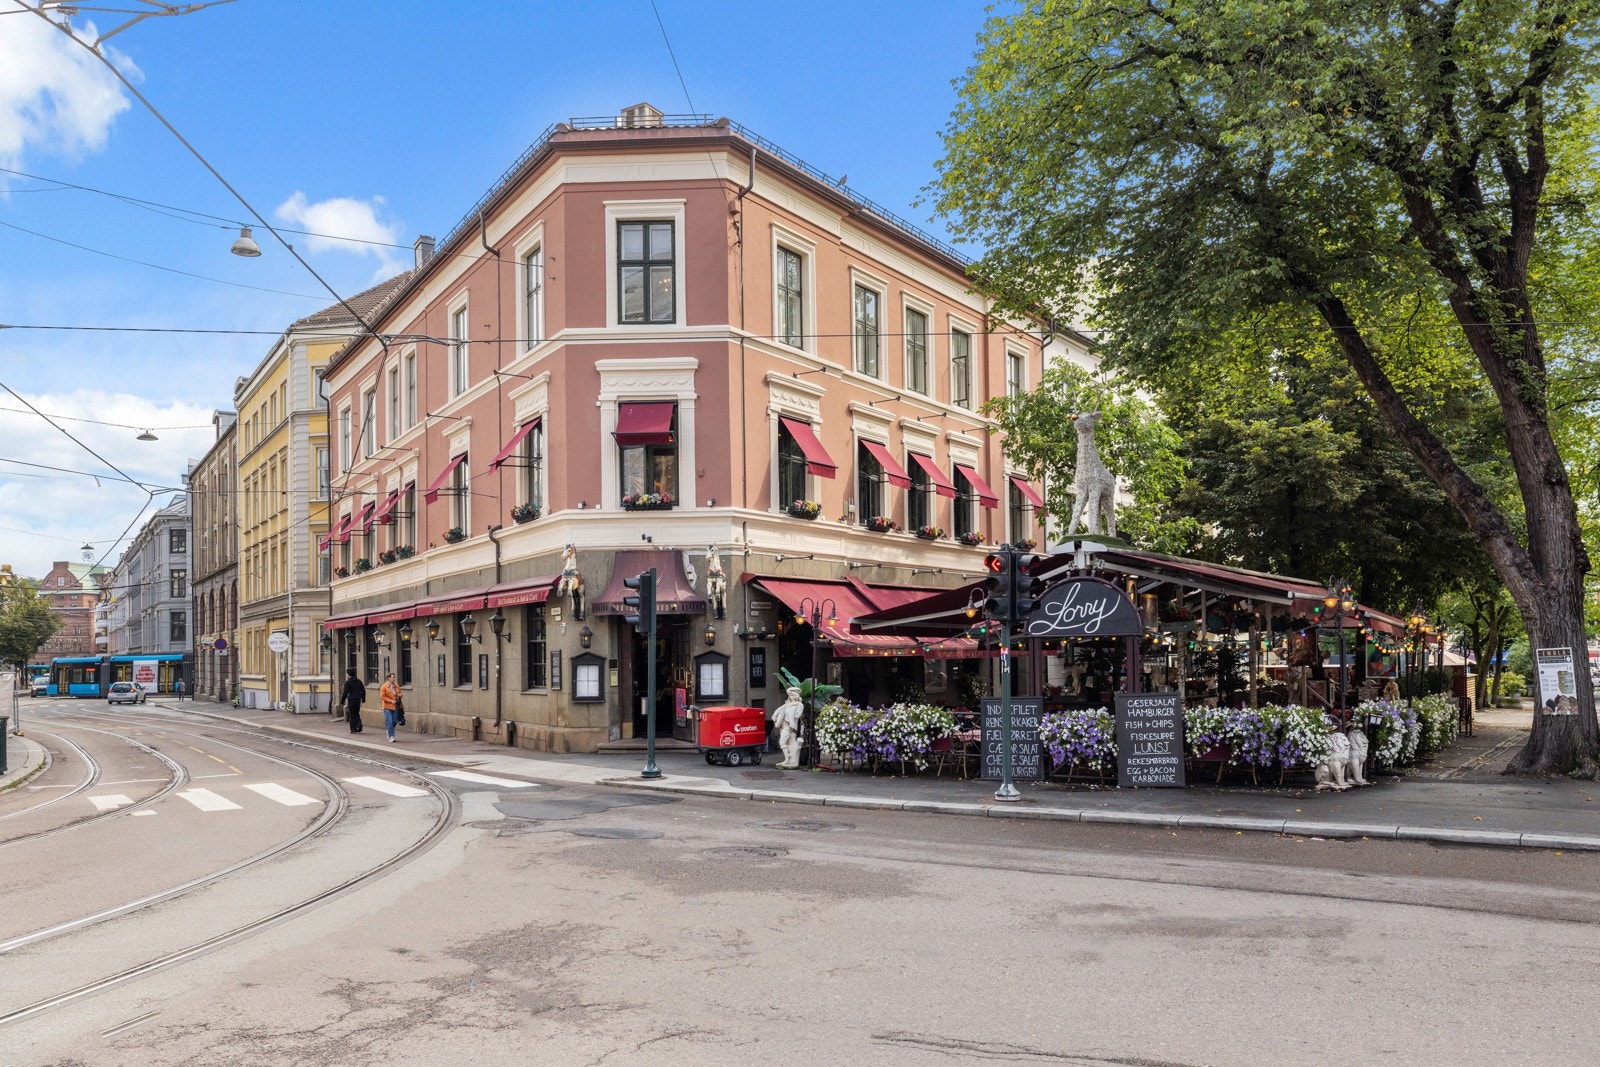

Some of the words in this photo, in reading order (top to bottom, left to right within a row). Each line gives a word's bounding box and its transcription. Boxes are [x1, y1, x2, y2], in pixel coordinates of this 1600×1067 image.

[1028, 582, 1121, 635] Lorry
[1127, 698, 1176, 708] CÆSERSALAT
[986, 704, 1038, 715] INDFILET
[1127, 708, 1175, 717] HAMBURGER
[1125, 720, 1142, 729] FISH
[1152, 720, 1174, 728] CHIPS
[1130, 732, 1175, 740] FISKESUPPE
[1018, 744, 1039, 754] SALAT
[1134, 742, 1170, 754] LUNSJ
[986, 754, 1018, 766] CHEE
[1018, 754, 1040, 766] SALAT
[1150, 766, 1176, 774] BACON
[1132, 774, 1176, 782] KARBONADE
